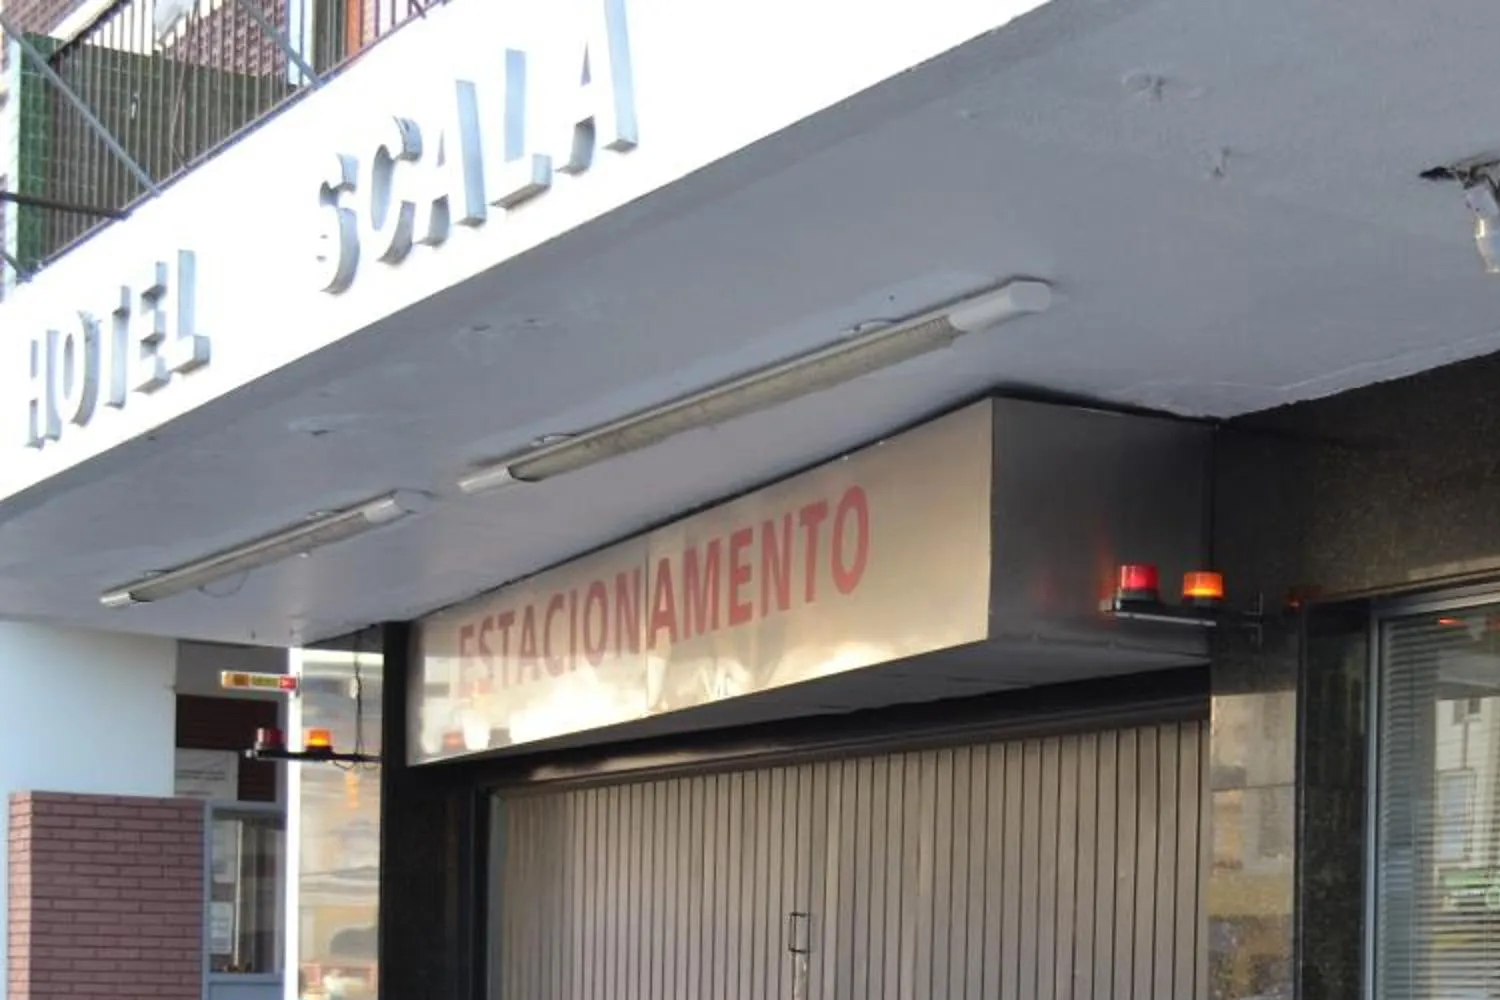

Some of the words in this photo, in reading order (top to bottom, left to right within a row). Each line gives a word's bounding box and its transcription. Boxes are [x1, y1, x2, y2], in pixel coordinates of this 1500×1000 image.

[24, 248, 211, 450] HOTEL
[315, 0, 638, 297] SCALA
[458, 485, 870, 697] ESTACIONAMENTO
